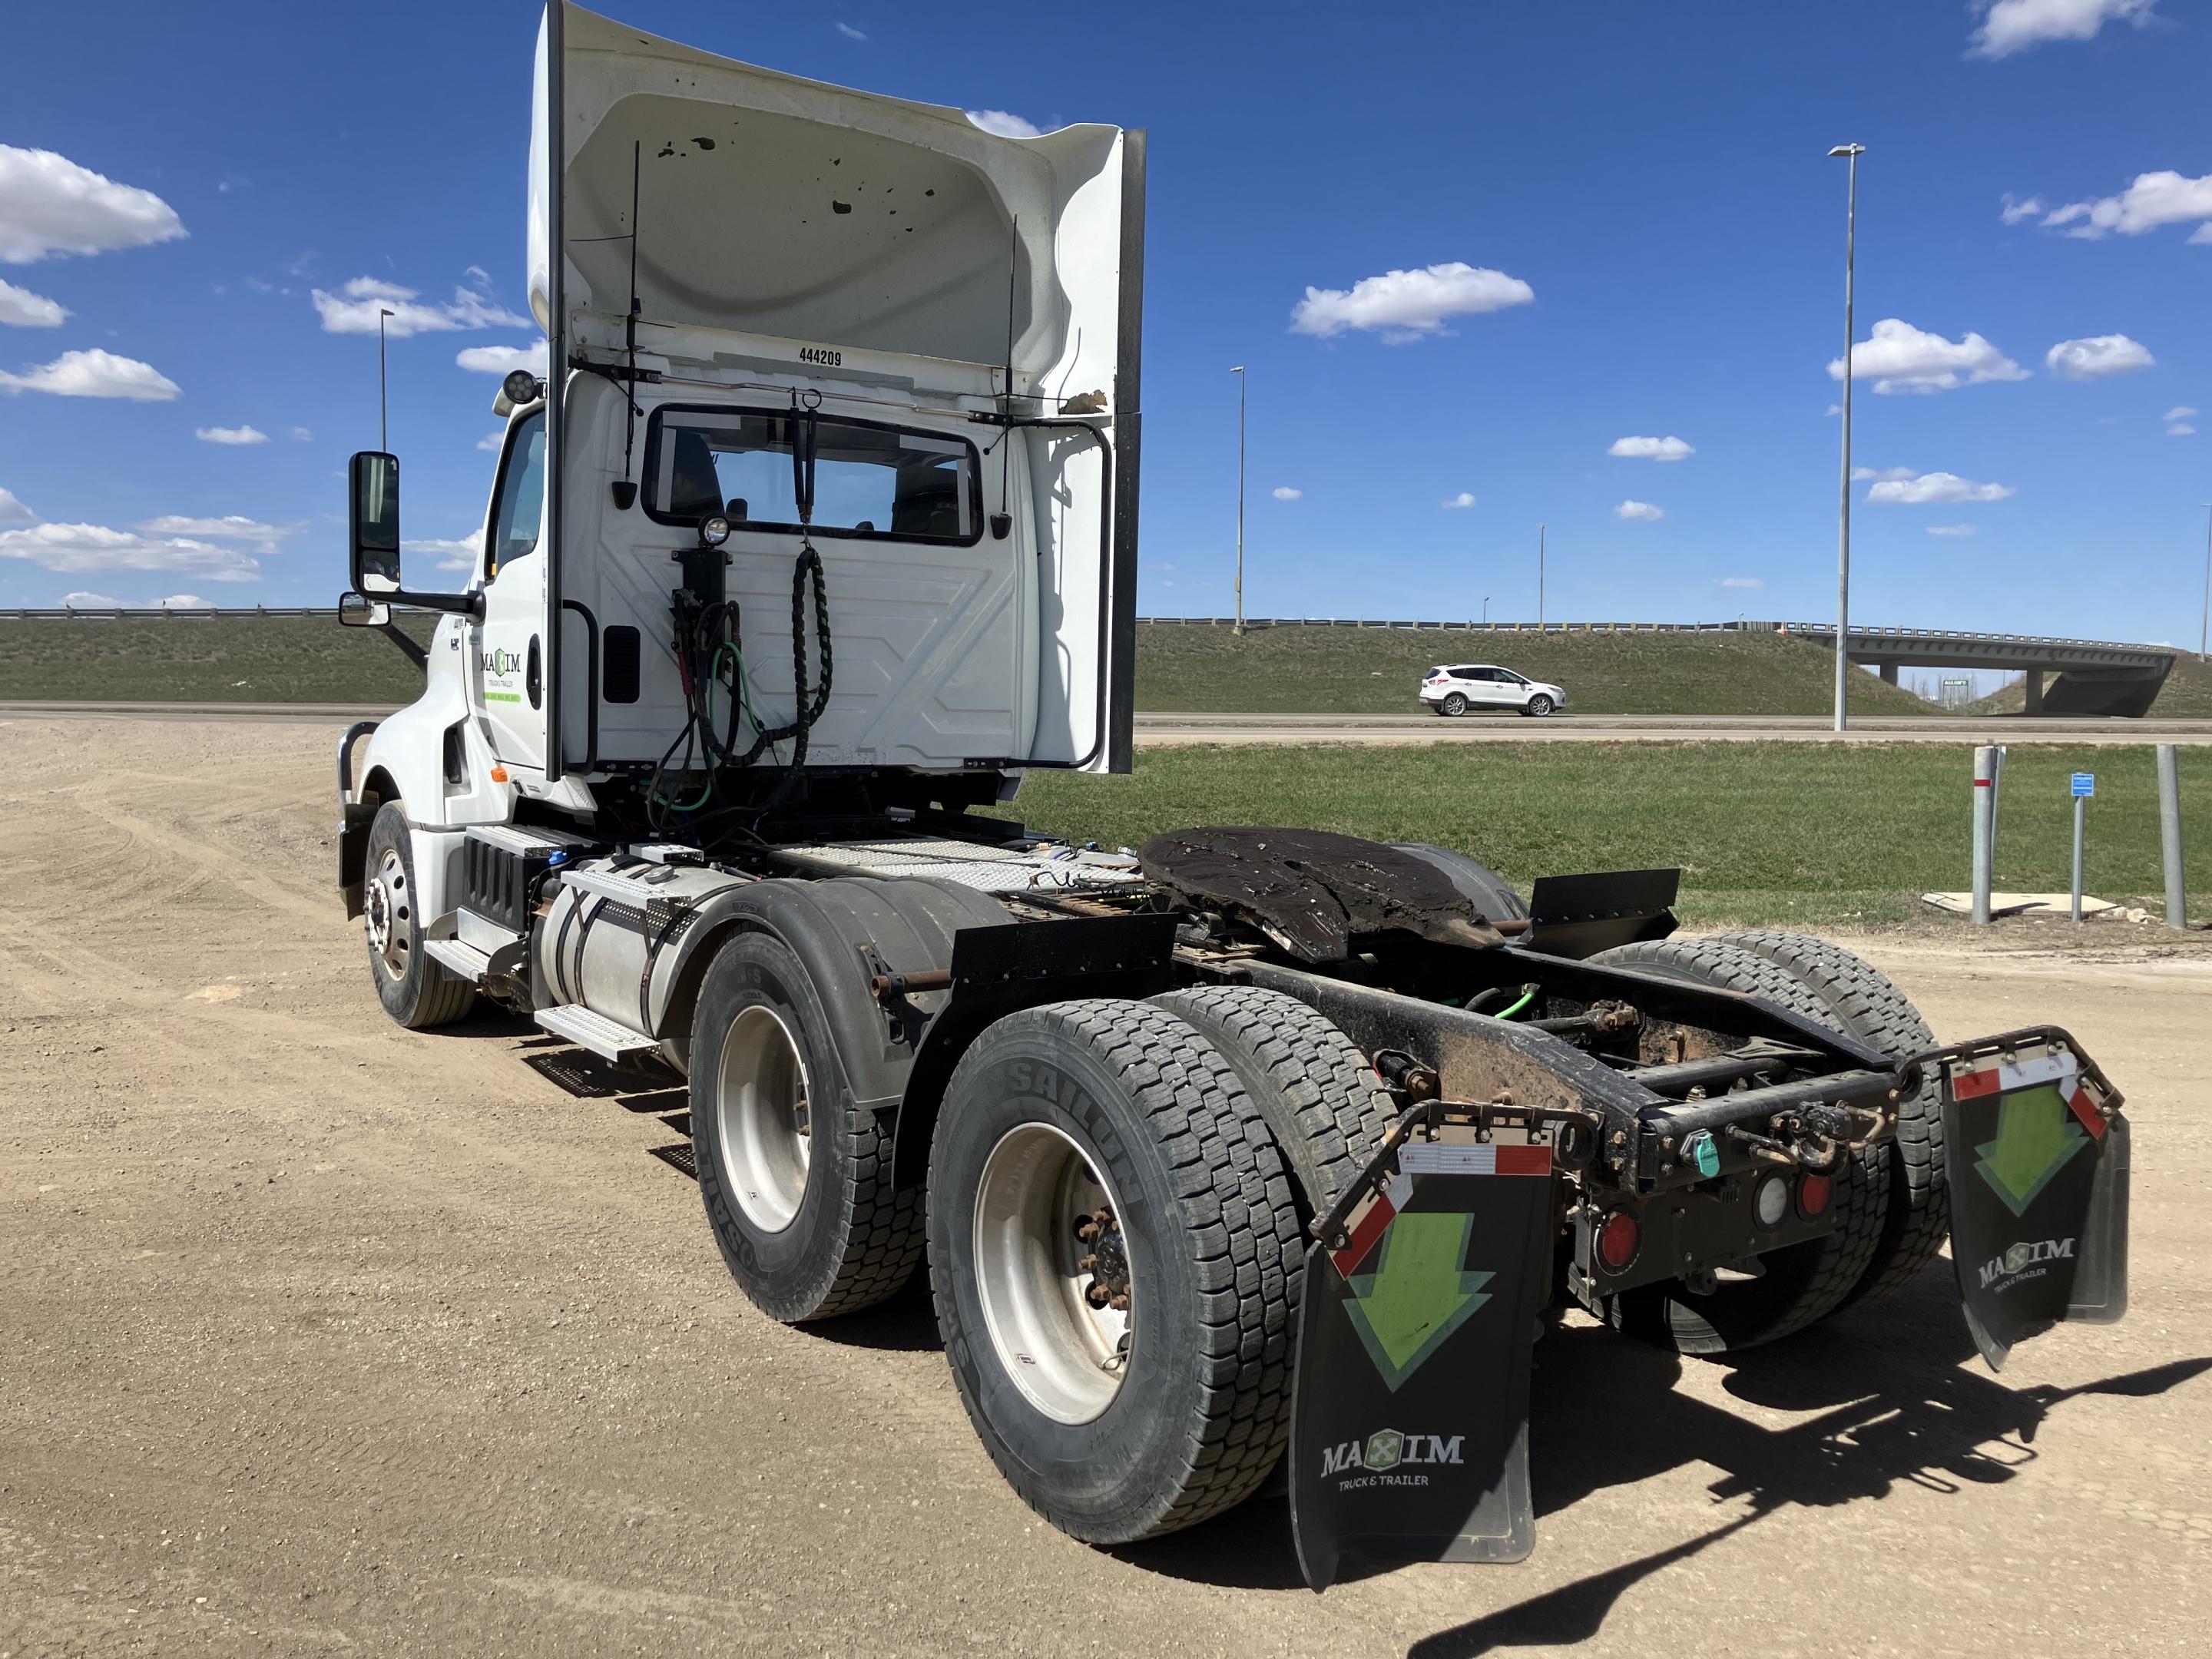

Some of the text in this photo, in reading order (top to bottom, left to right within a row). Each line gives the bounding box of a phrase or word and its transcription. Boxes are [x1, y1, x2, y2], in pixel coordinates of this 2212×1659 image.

[800, 347, 842, 366] 444209
[480, 648, 521, 677] MAXIM
[1008, 1062, 1144, 1205] SAILUN
[1979, 1237, 2076, 1289] MAXIM
[2015, 1267, 2048, 1282] TRAILER
[1320, 1428, 1465, 1479] MAXIM
[1339, 1475, 1429, 1492] TRUCK & TRAILER
